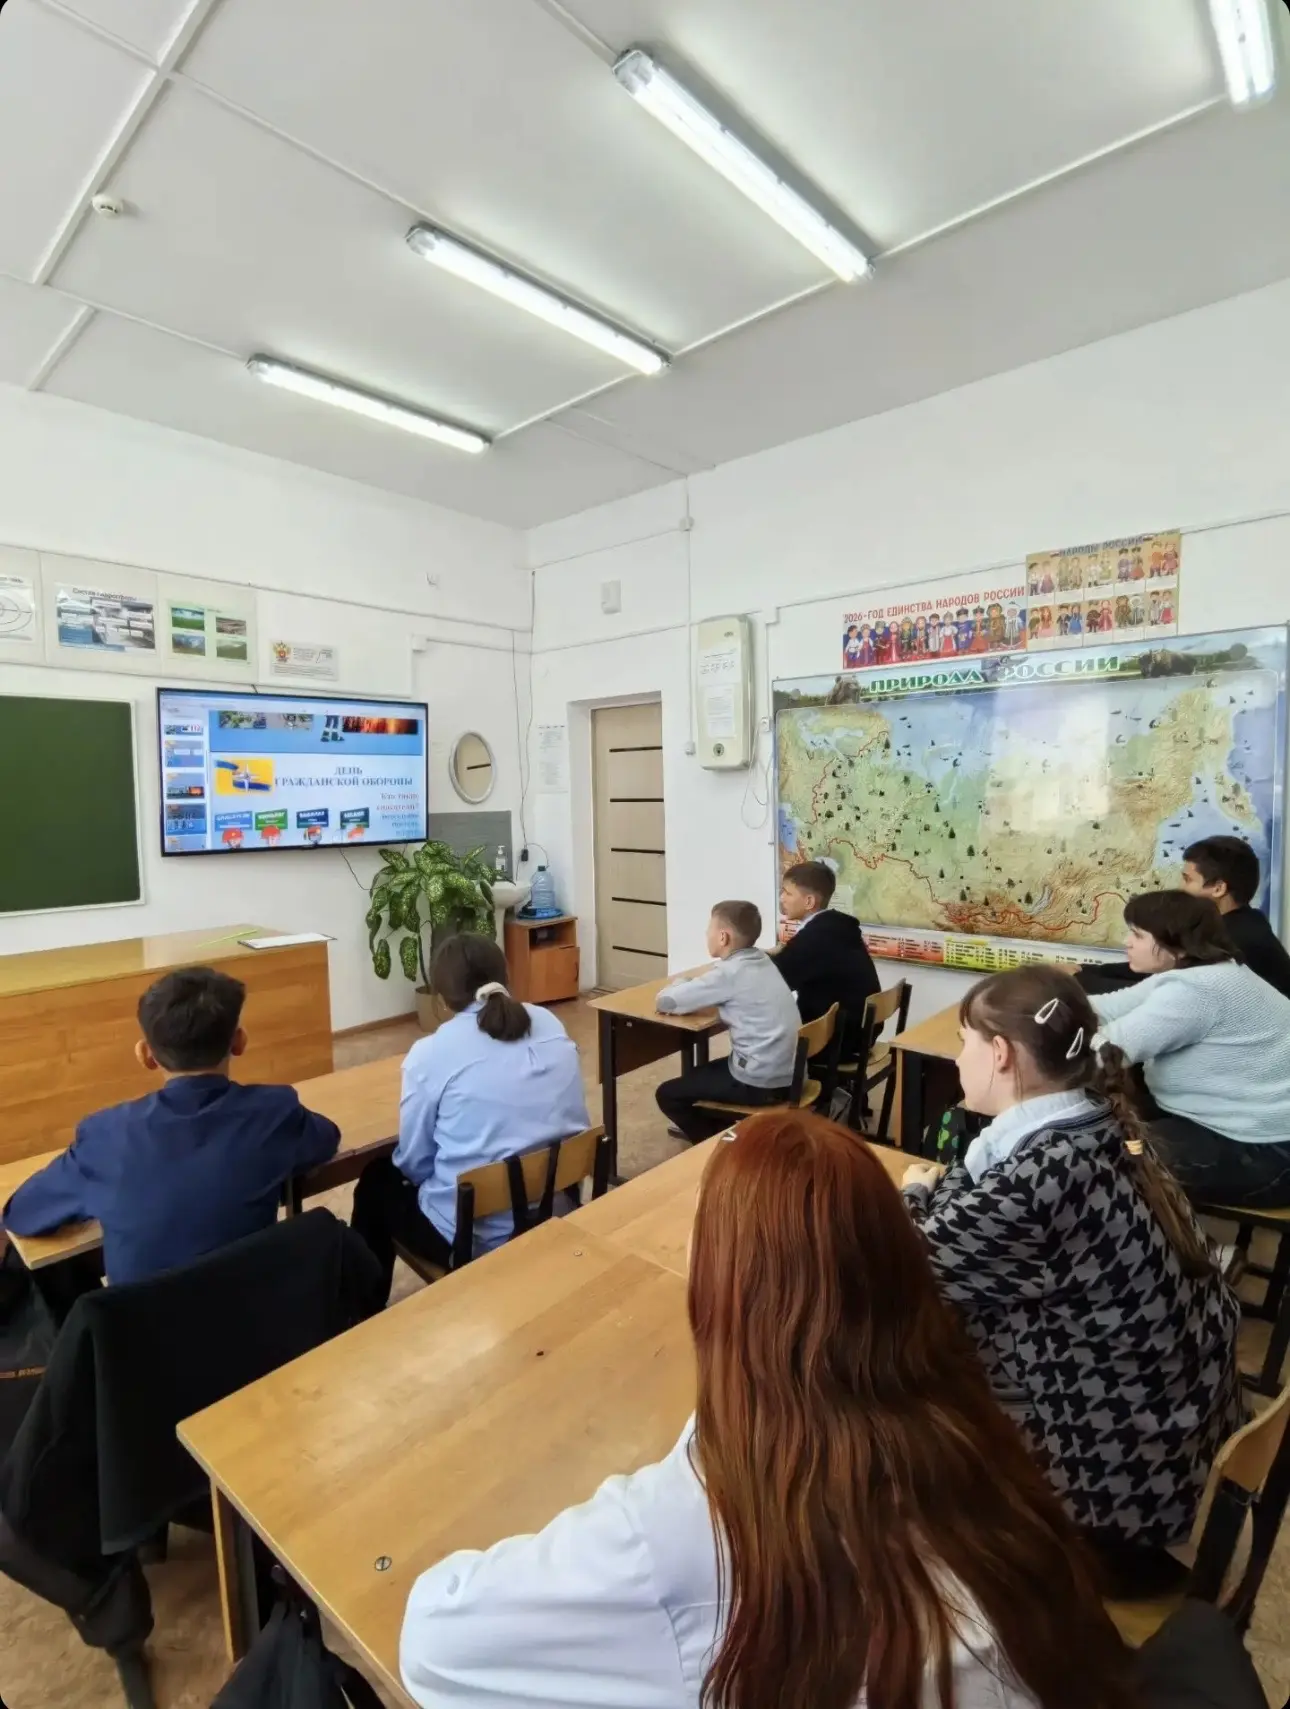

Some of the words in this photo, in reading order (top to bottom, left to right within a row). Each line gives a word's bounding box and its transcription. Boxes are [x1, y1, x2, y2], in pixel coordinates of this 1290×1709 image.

[1060, 544, 1098, 557] НАРОДЫ
[1102, 536, 1144, 549] РОССИИ
[887, 600, 933, 617] ЕДИНСТВА
[936, 593, 980, 610] НАРОДОВ
[984, 585, 1025, 601] РОССИИ
[869, 668, 984, 693] ПРИРОДА
[998, 656, 1121, 681] РОССИИ
[274, 776, 359, 787] ГРАЖДАНСКОЙ
[361, 777, 414, 786] ОБОРОНЫ
[333, 766, 363, 776] ДЕНЬ
